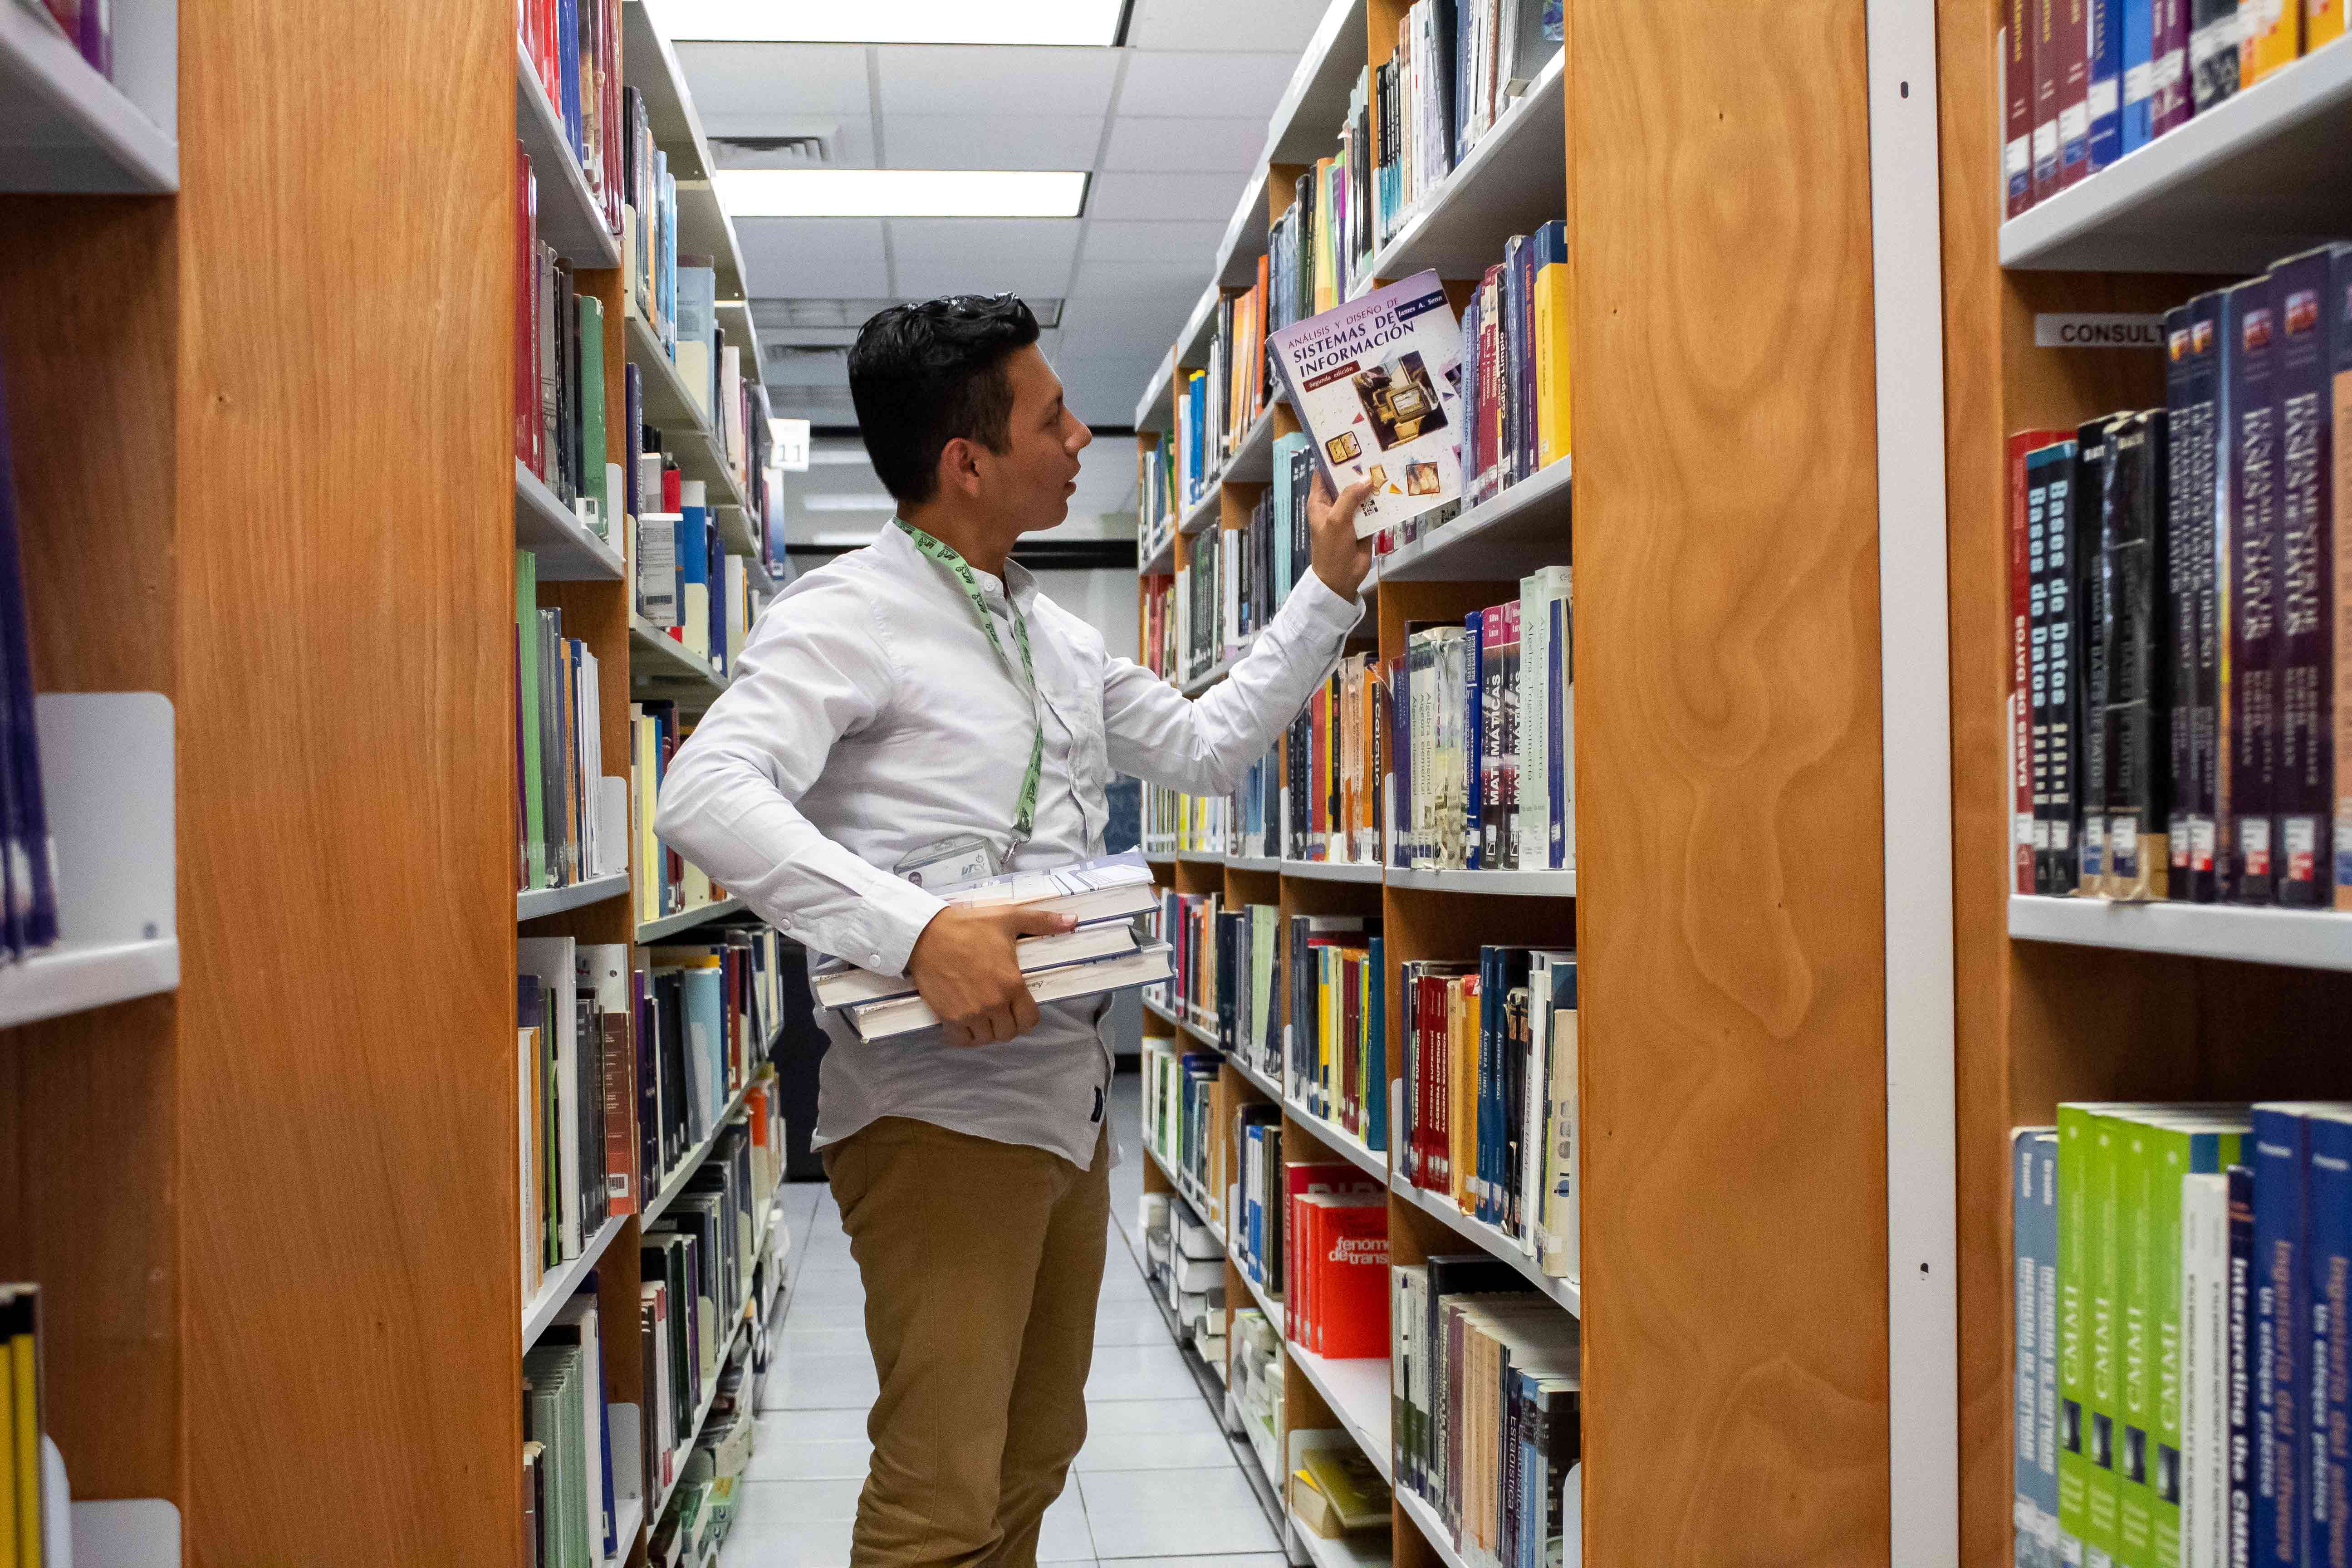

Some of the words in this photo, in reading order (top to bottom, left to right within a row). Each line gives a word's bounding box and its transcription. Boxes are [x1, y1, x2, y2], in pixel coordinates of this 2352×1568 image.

[1289, 325, 1330, 348] ANÁLISIS
[1335, 320, 1340, 329] Y
[1346, 304, 1382, 325] DISEÑO
[1387, 297, 1399, 309] DE
[1398, 306, 1416, 318] James
[1427, 295, 1442, 305] Senn
[1294, 323, 1366, 363] SISTEMAS
[1375, 311, 1395, 330] DE
[1300, 320, 1415, 377] INFORMACIÓN
[1309, 376, 1331, 388] Segunda
[1333, 366, 1353, 378] edición
[778, 444, 802, 462] 11
[1328, 1247, 1348, 1261] de
[2230, 1258, 2248, 1426] Interpreting
[2233, 1435, 2248, 1482] the
